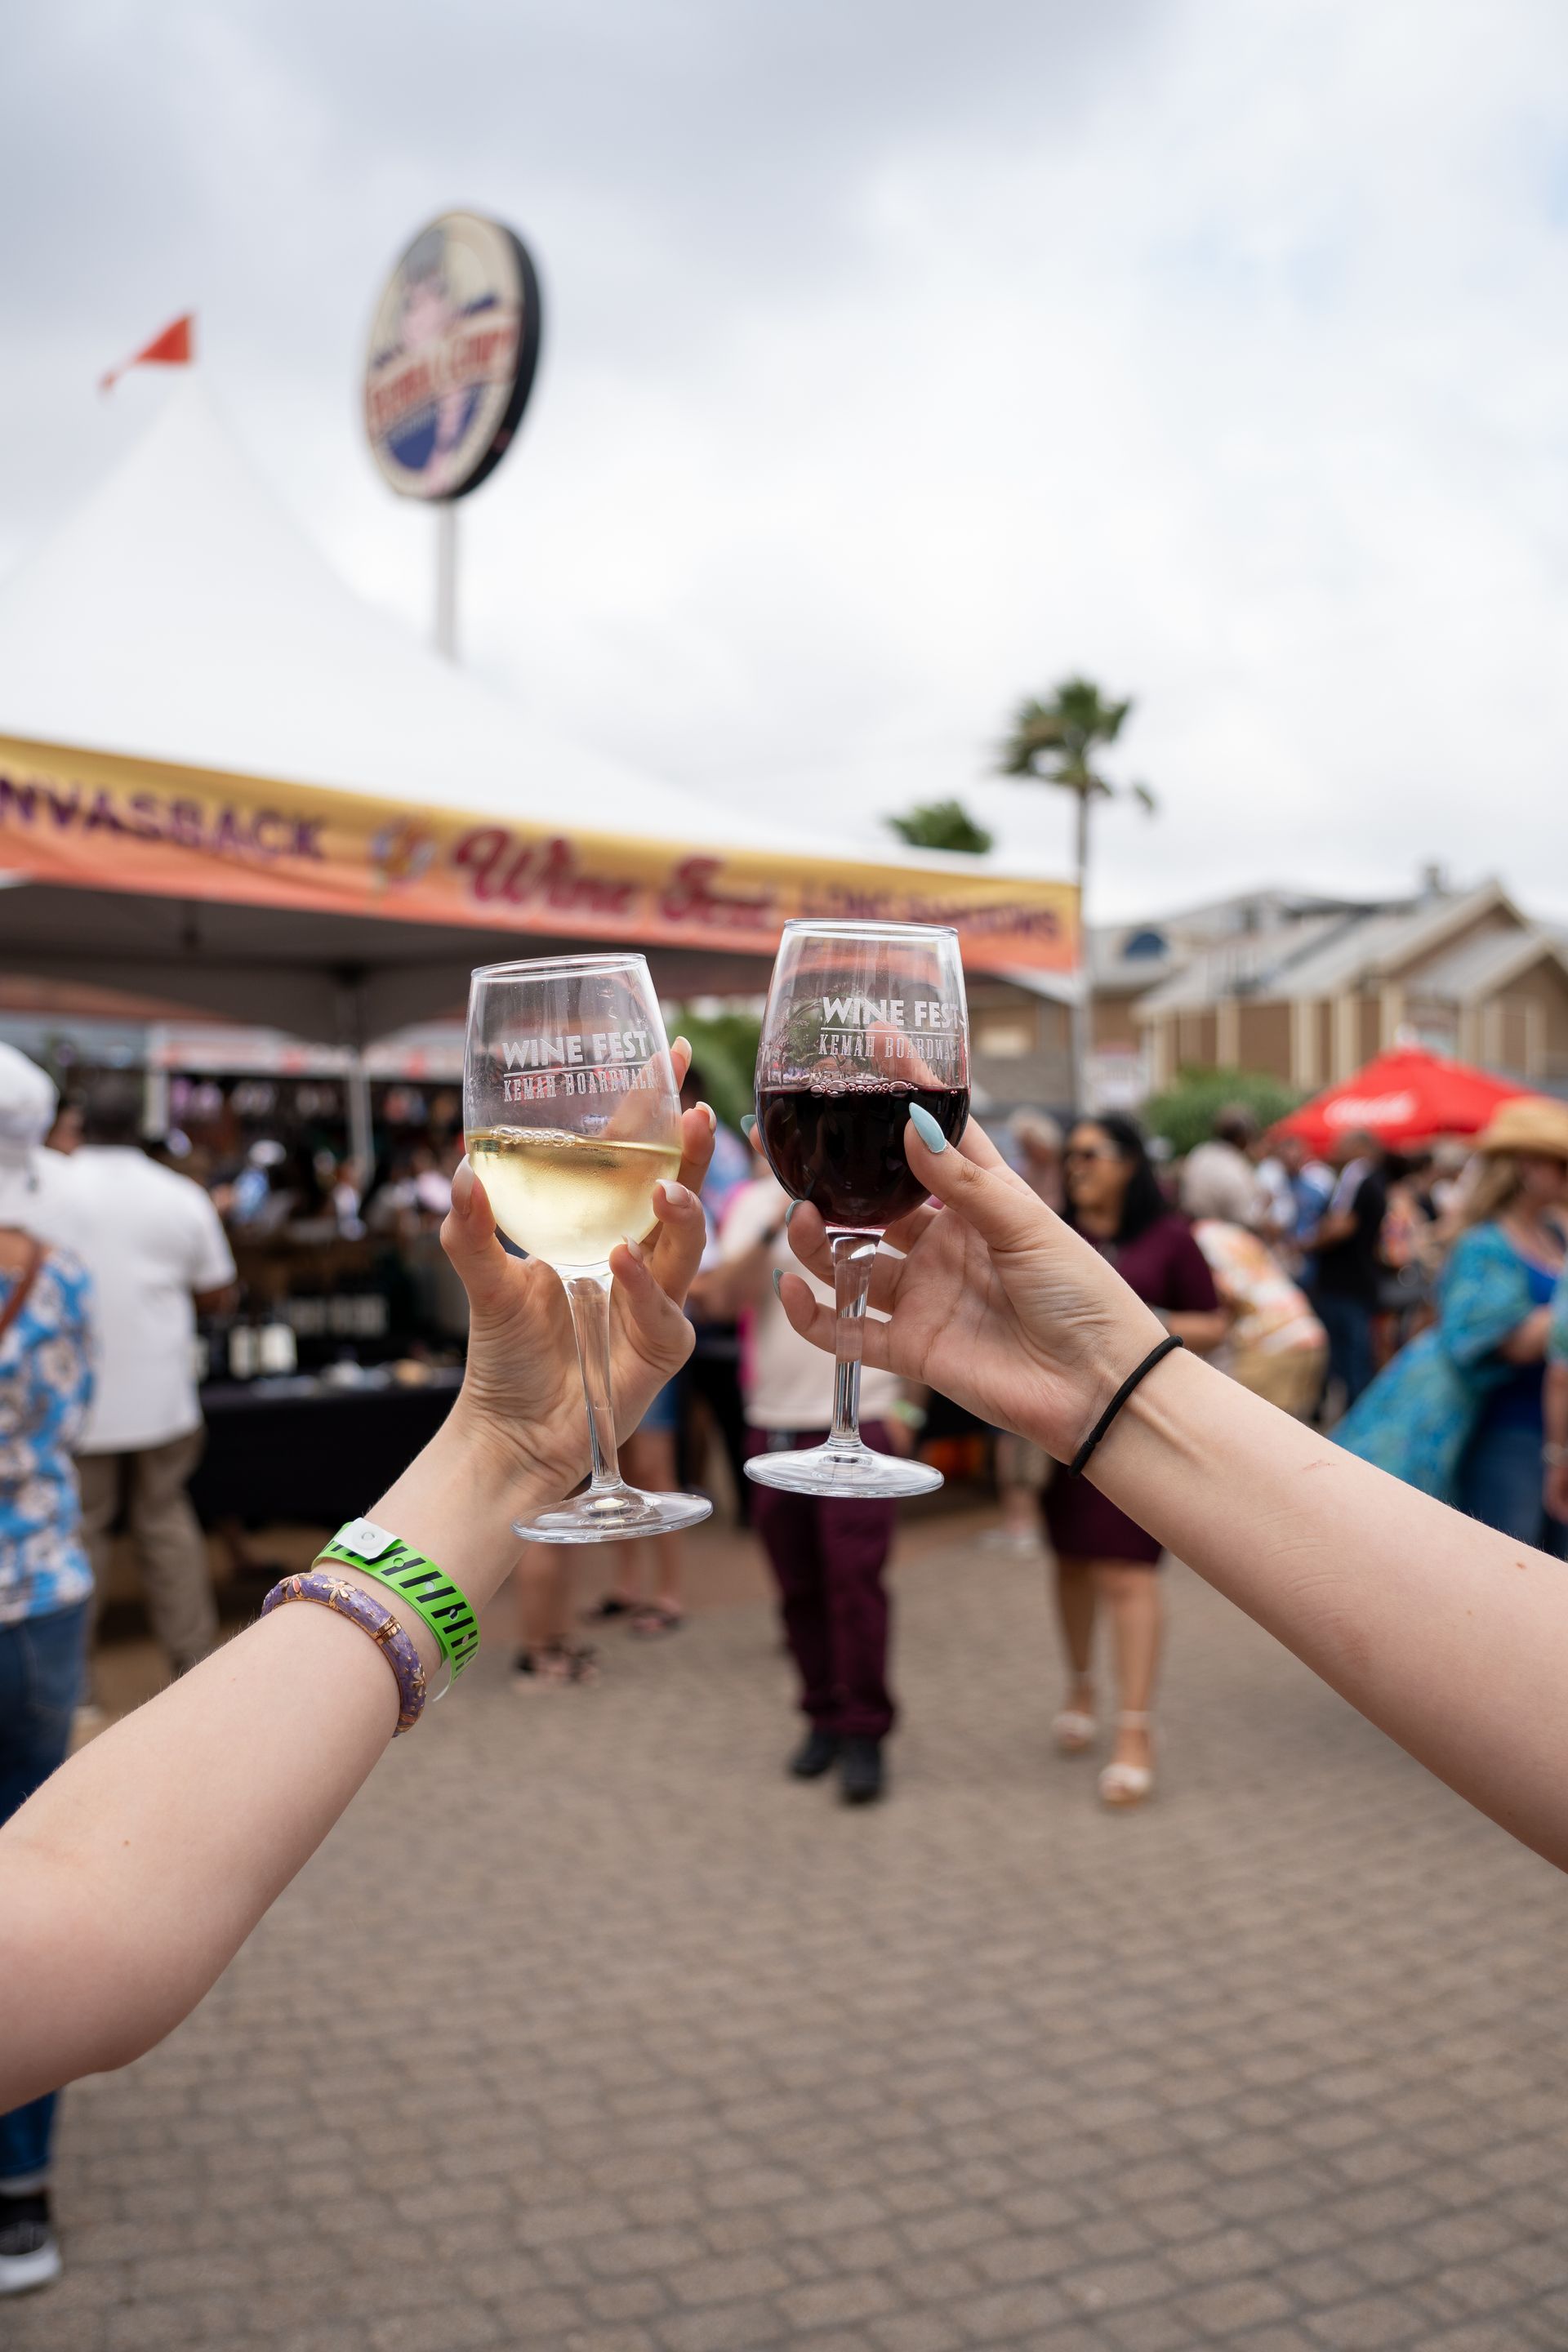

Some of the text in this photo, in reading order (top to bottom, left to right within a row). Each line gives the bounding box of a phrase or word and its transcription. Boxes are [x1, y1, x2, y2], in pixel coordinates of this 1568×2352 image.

[823, 997, 960, 1029] WINE FEST
[502, 1031, 647, 1070] WINE FEST
[819, 1034, 875, 1057] KEMAH
[504, 1068, 654, 1102] KEMAH BOARDWALK
